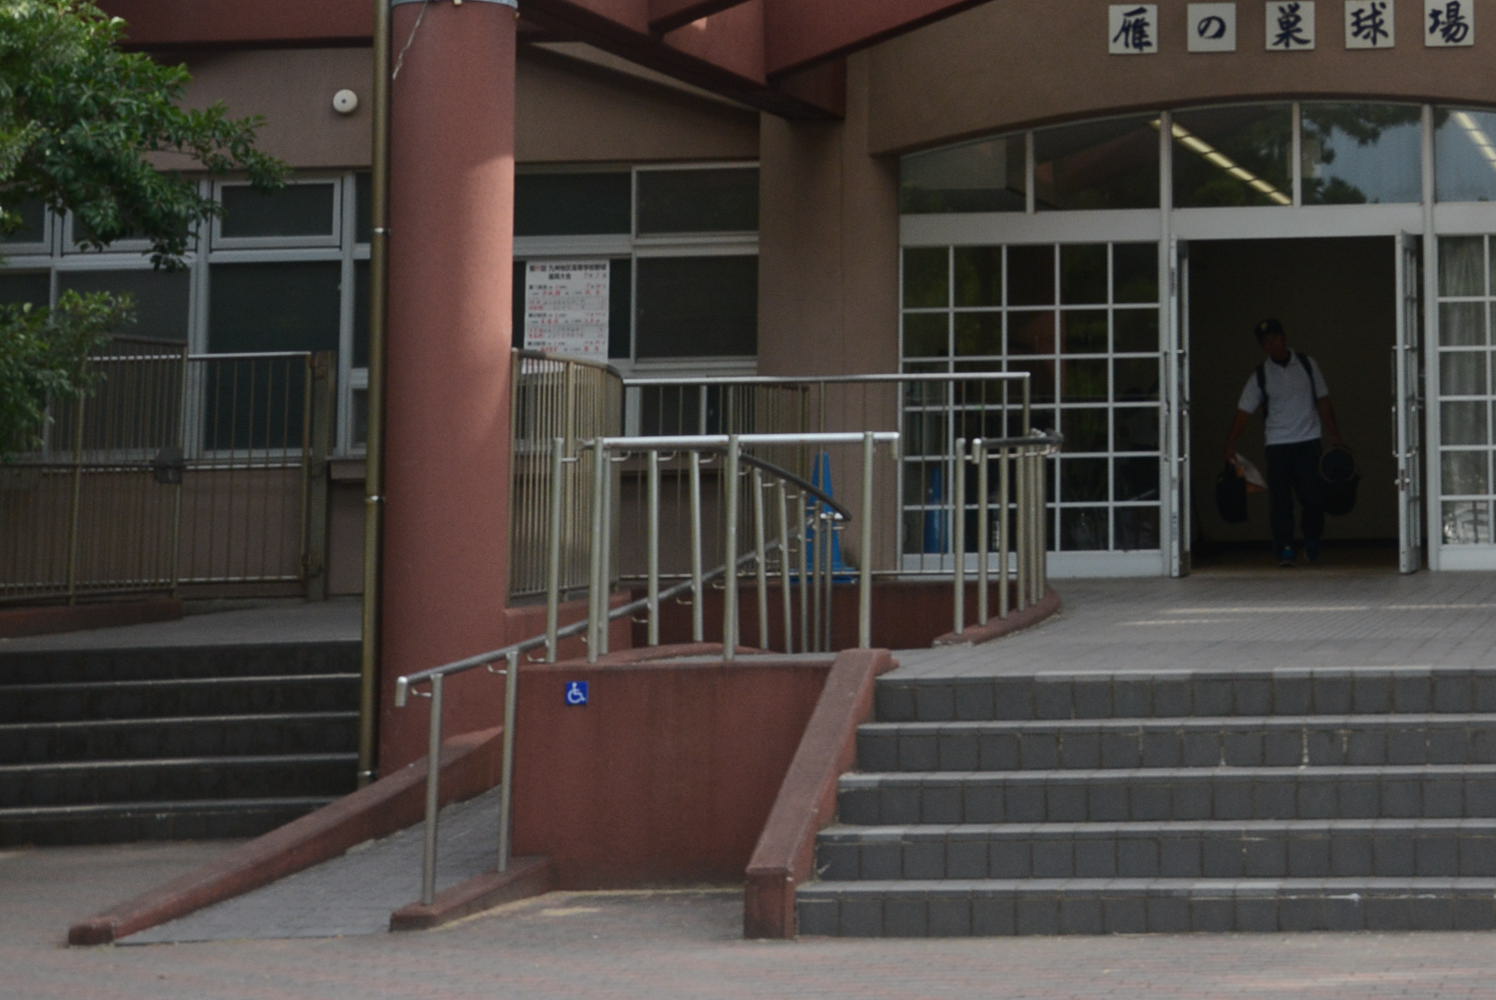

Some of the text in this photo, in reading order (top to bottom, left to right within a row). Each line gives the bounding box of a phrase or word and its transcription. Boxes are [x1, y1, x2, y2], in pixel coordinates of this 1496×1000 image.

[1113, 0, 1470, 51] 雁の巣球場
